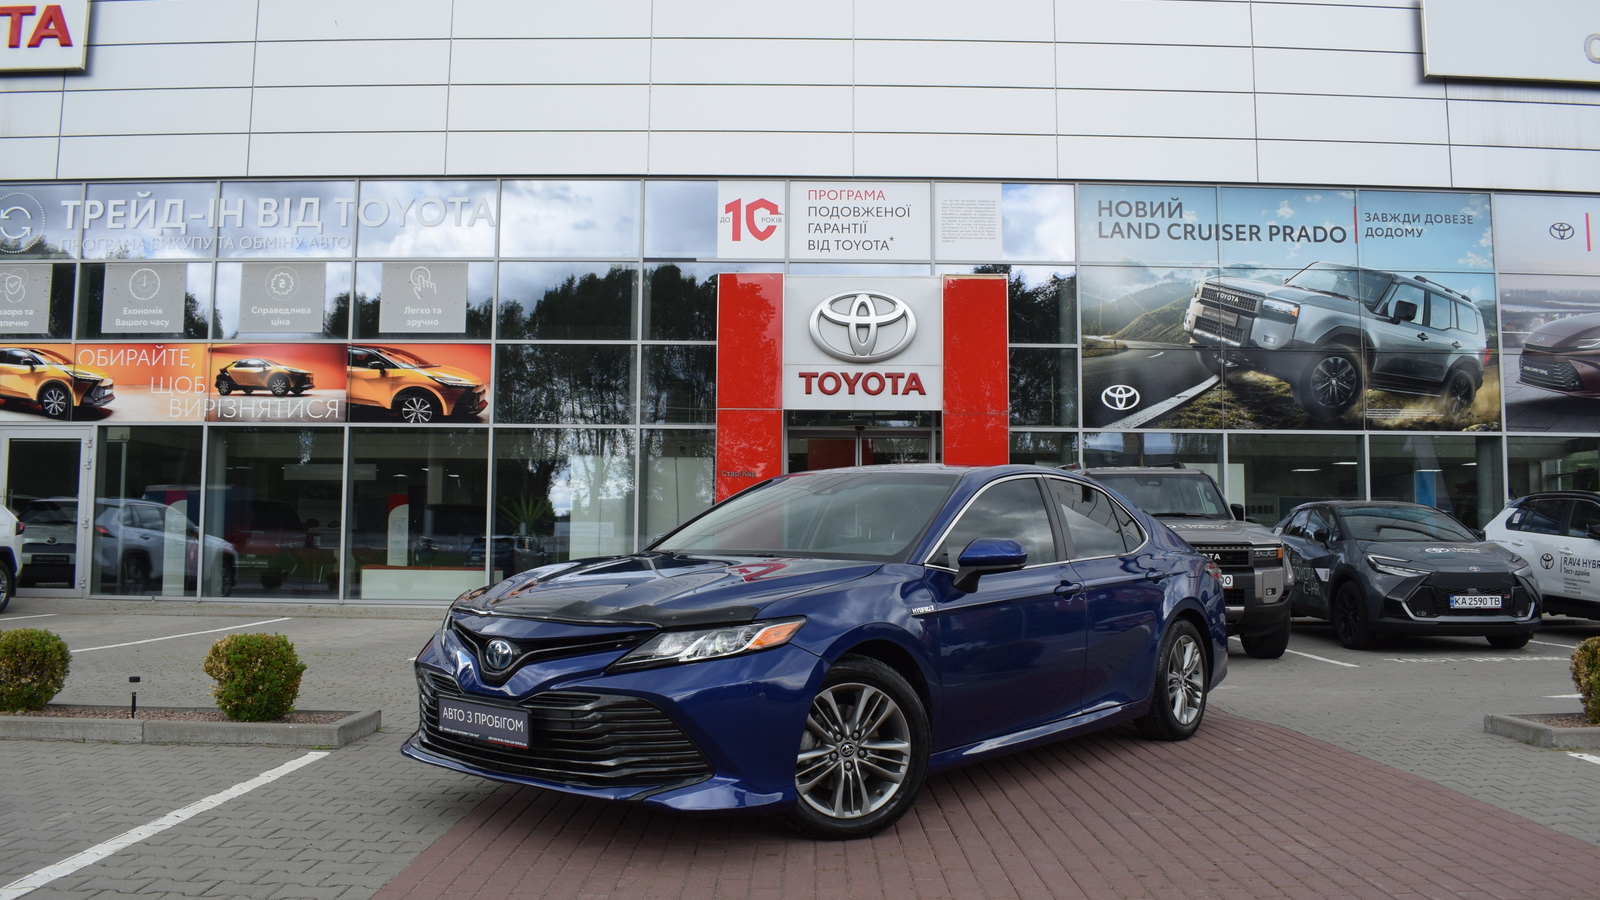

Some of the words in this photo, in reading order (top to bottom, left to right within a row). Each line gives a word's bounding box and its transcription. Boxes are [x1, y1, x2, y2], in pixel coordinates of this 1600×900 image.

[808, 190, 886, 201] ПРОГРАМА
[61, 191, 244, 235] ТРЕЙД-ІН
[258, 197, 323, 234] ВІД
[334, 197, 496, 228] TOYOTA
[808, 204, 911, 219] ПОДОВЖЕНОЇ
[1098, 197, 1183, 219] НОВИЙ
[1365, 212, 1420, 225] ЗАВЖДИ
[1425, 214, 1474, 225] ДОВЕЗЕ
[808, 221, 868, 234] ГАРАНТІЇ
[1098, 222, 1161, 240] LAND
[1167, 223, 1262, 242] CRUISER
[1269, 225, 1347, 244] PRADO
[1365, 227, 1423, 239] ДОДОМУ
[59, 237, 145, 251] ПРОГРАМА
[150, 236, 214, 250] ВИКУПУ
[217, 236, 236, 250] ТА
[239, 236, 305, 250] ОБМІНУ
[308, 235, 350, 249] АВТО
[808, 240, 831, 252] ВІД
[1216, 292, 1239, 303] TOYOTA
[123, 306, 163, 315] Економія
[251, 306, 311, 316] Справедлива
[404, 306, 432, 316] Легко
[433, 307, 442, 315] та
[149, 319, 170, 328] часу
[271, 317, 290, 326] ціна
[406, 318, 439, 327] зручно
[77, 345, 196, 369] ОБИРАЙТЕ,
[150, 376, 206, 396] ЩОБ
[798, 371, 927, 396] TOYOTA
[169, 399, 339, 419] ВИРІЗНЯТИСЯ
[721, 470, 756, 478] Стар-Кар
[1563, 556, 1581, 567] RAV4
[1563, 567, 1590, 577] Тест-драйв
[1303, 581, 1320, 596] C-HR
[1454, 597, 1467, 605] KA
[1468, 597, 1488, 606] 2590
[1489, 597, 1501, 606] TB
[442, 706, 465, 722] АВТО
[466, 710, 473, 723] З
[474, 712, 524, 733] ПРОБІГОМ
